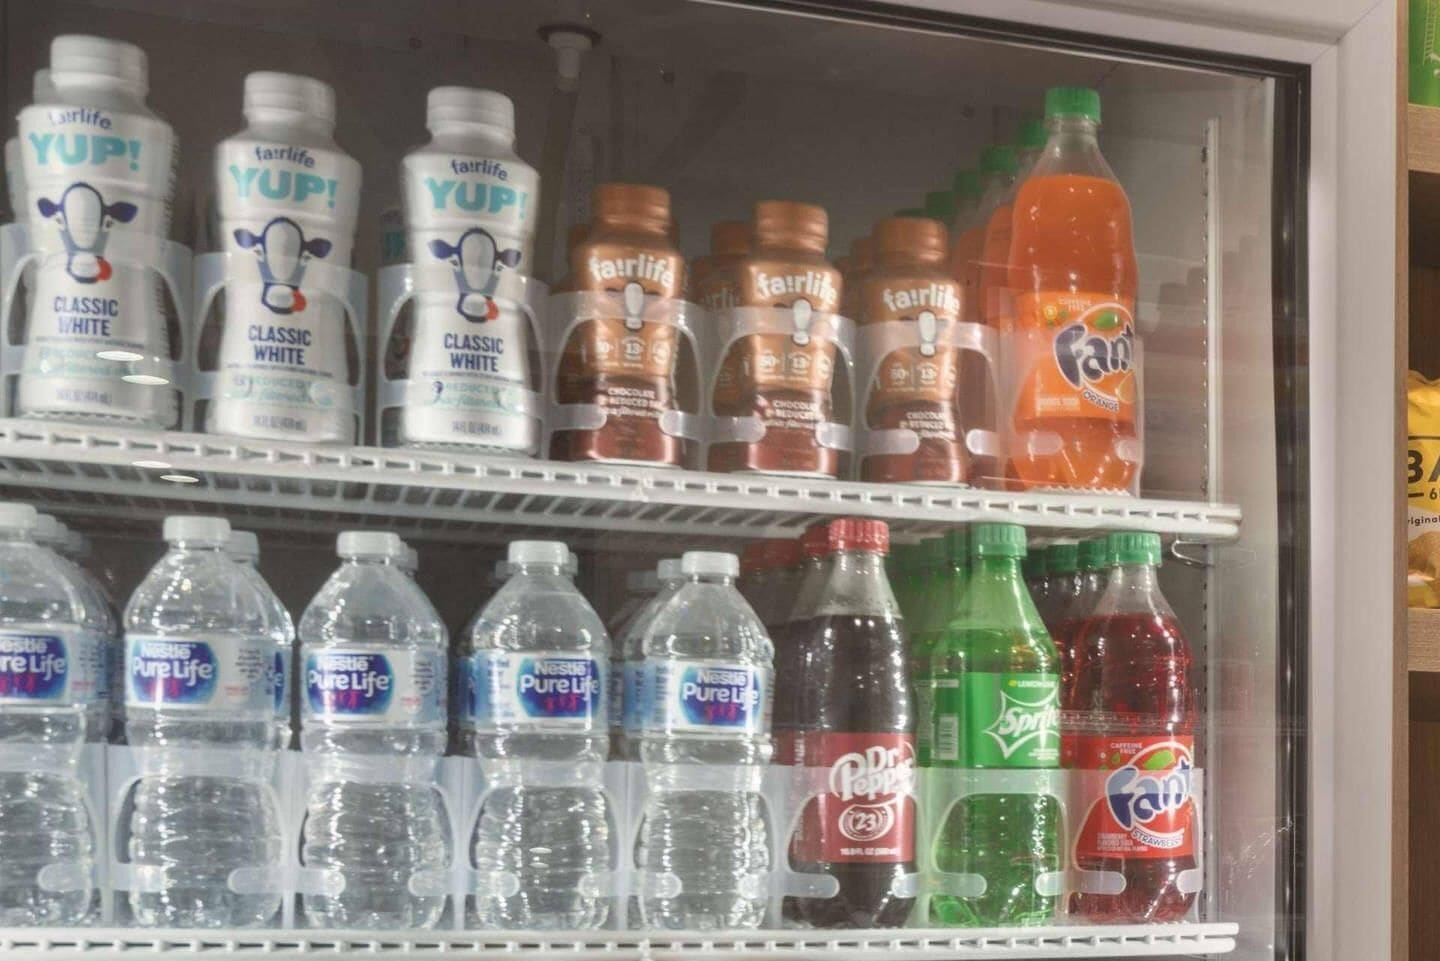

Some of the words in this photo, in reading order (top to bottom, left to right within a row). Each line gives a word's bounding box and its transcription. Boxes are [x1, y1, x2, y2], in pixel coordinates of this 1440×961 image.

[29, 132, 142, 171] YUP!
[229, 165, 337, 208] YUP!
[424, 177, 528, 221] YUP!
[54, 296, 119, 317] CLASSIC
[58, 317, 111, 336] WHITE
[248, 325, 312, 346] CLASSIC
[254, 345, 305, 365] WHITE
[444, 333, 504, 354] CLASSIC
[1053, 322, 1136, 391] Fan
[451, 352, 499, 372] WHITE
[1082, 389, 1119, 413] ORANGE
[0, 655, 27, 673] re
[29, 654, 65, 681] Life
[132, 656, 171, 678] Pure
[173, 660, 213, 687] Life
[308, 669, 350, 690] Pure
[351, 671, 390, 698] Life
[520, 674, 570, 693] Pure
[571, 675, 600, 701] Life
[681, 682, 730, 702] Pure
[731, 686, 760, 711] Life
[998, 704, 1060, 738] Sprit
[866, 745, 899, 774] Dr
[829, 752, 913, 802] Pepp
[1105, 755, 1191, 832] Fant
[855, 812, 876, 831] 23
[1132, 828, 1183, 850] STRAWBER
